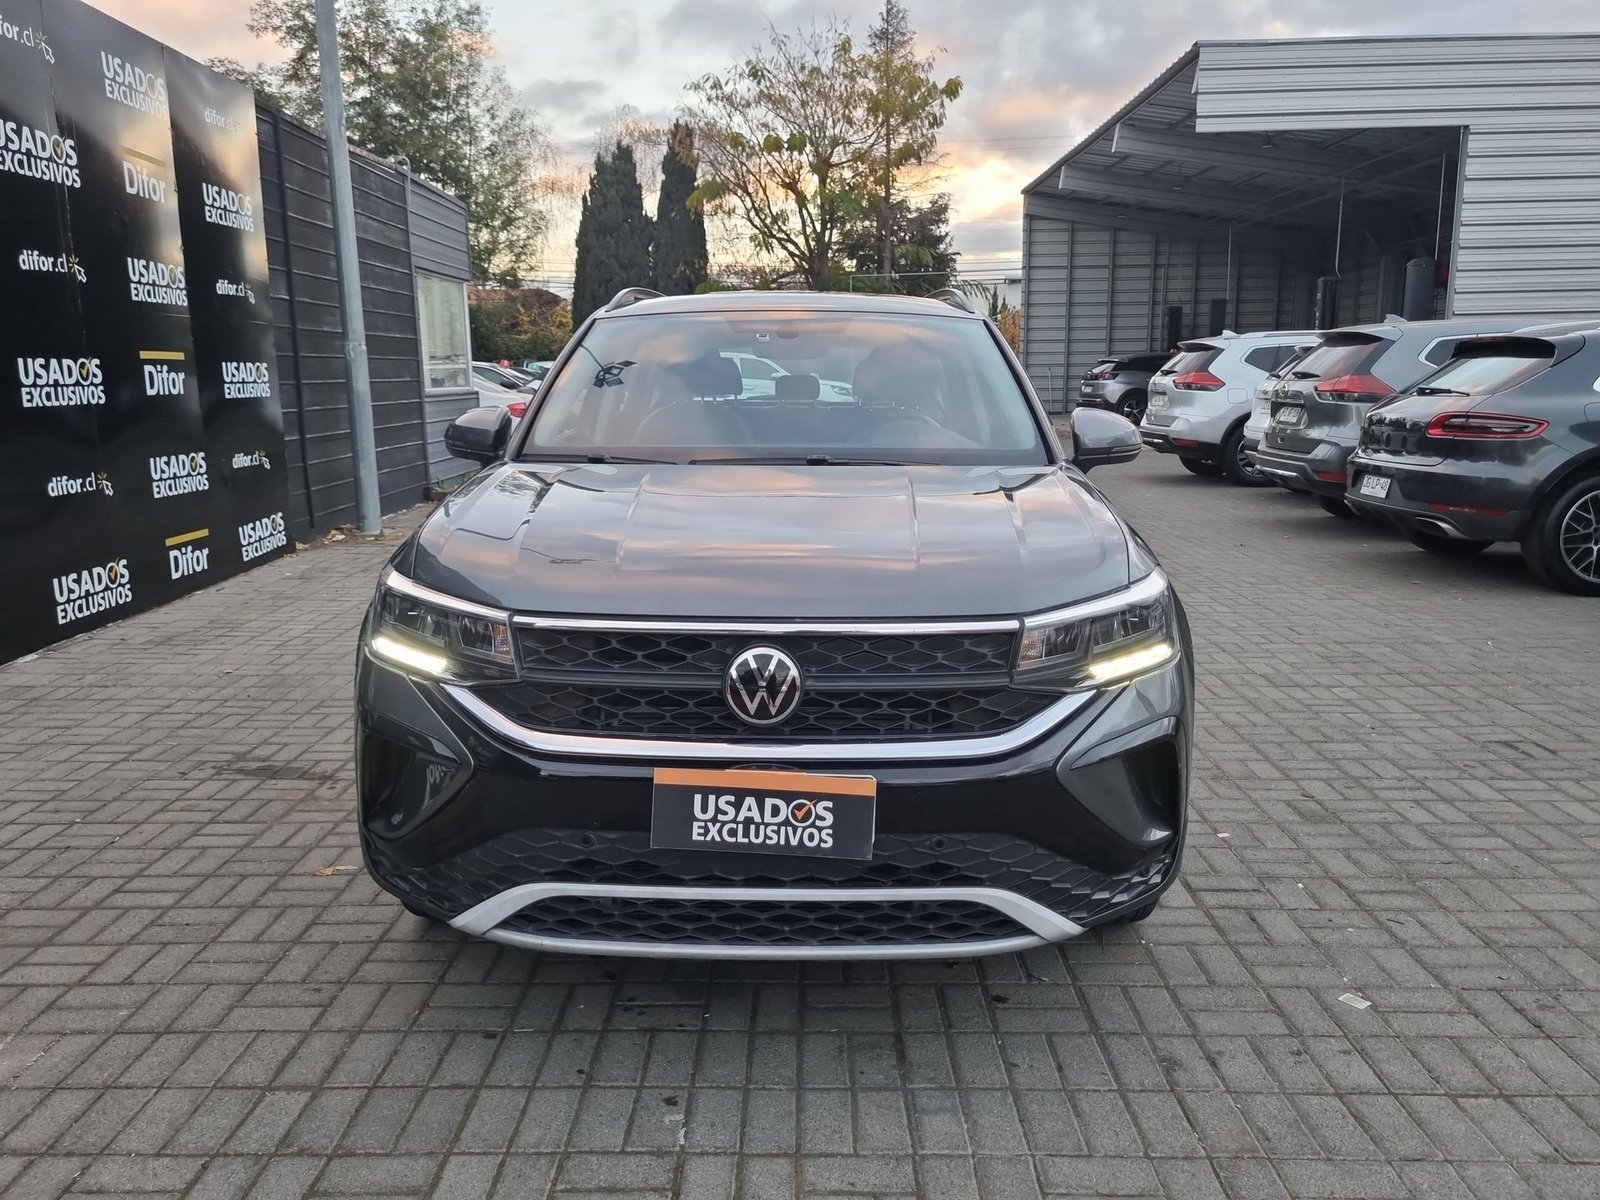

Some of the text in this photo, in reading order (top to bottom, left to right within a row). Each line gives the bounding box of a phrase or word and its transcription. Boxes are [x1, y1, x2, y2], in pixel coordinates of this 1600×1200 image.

[101, 50, 166, 102] USADOS
[123, 160, 166, 203] Difor
[202, 182, 252, 217] USADOS
[204, 205, 254, 232] EXCLUSIVOS
[18, 249, 68, 273] difor.cl
[127, 256, 186, 288] USADOS
[130, 282, 188, 306] EXCLUSIVOS
[216, 278, 245, 297] difor.cl
[17, 356, 103, 386] USADOS
[143, 364, 186, 396] Difor
[221, 361, 269, 383] USADOS
[21, 385, 106, 408] EXCLUSIVOS
[224, 382, 271, 399] EXCLUSIVOS
[149, 452, 207, 481] USADOS
[232, 450, 260, 470] difor.cl
[47, 472, 97, 498] difor.cl
[152, 473, 209, 499] EXCLUSIVOS
[238, 511, 285, 546] USADOS
[241, 530, 287, 562] EXCLUSIVOS
[168, 545, 209, 580] Difor
[53, 558, 130, 603] USADOS
[56, 583, 133, 625] EXCLUSIVOS
[692, 793, 834, 828] USADOS
[691, 820, 834, 848] EXCLUSIVOS
